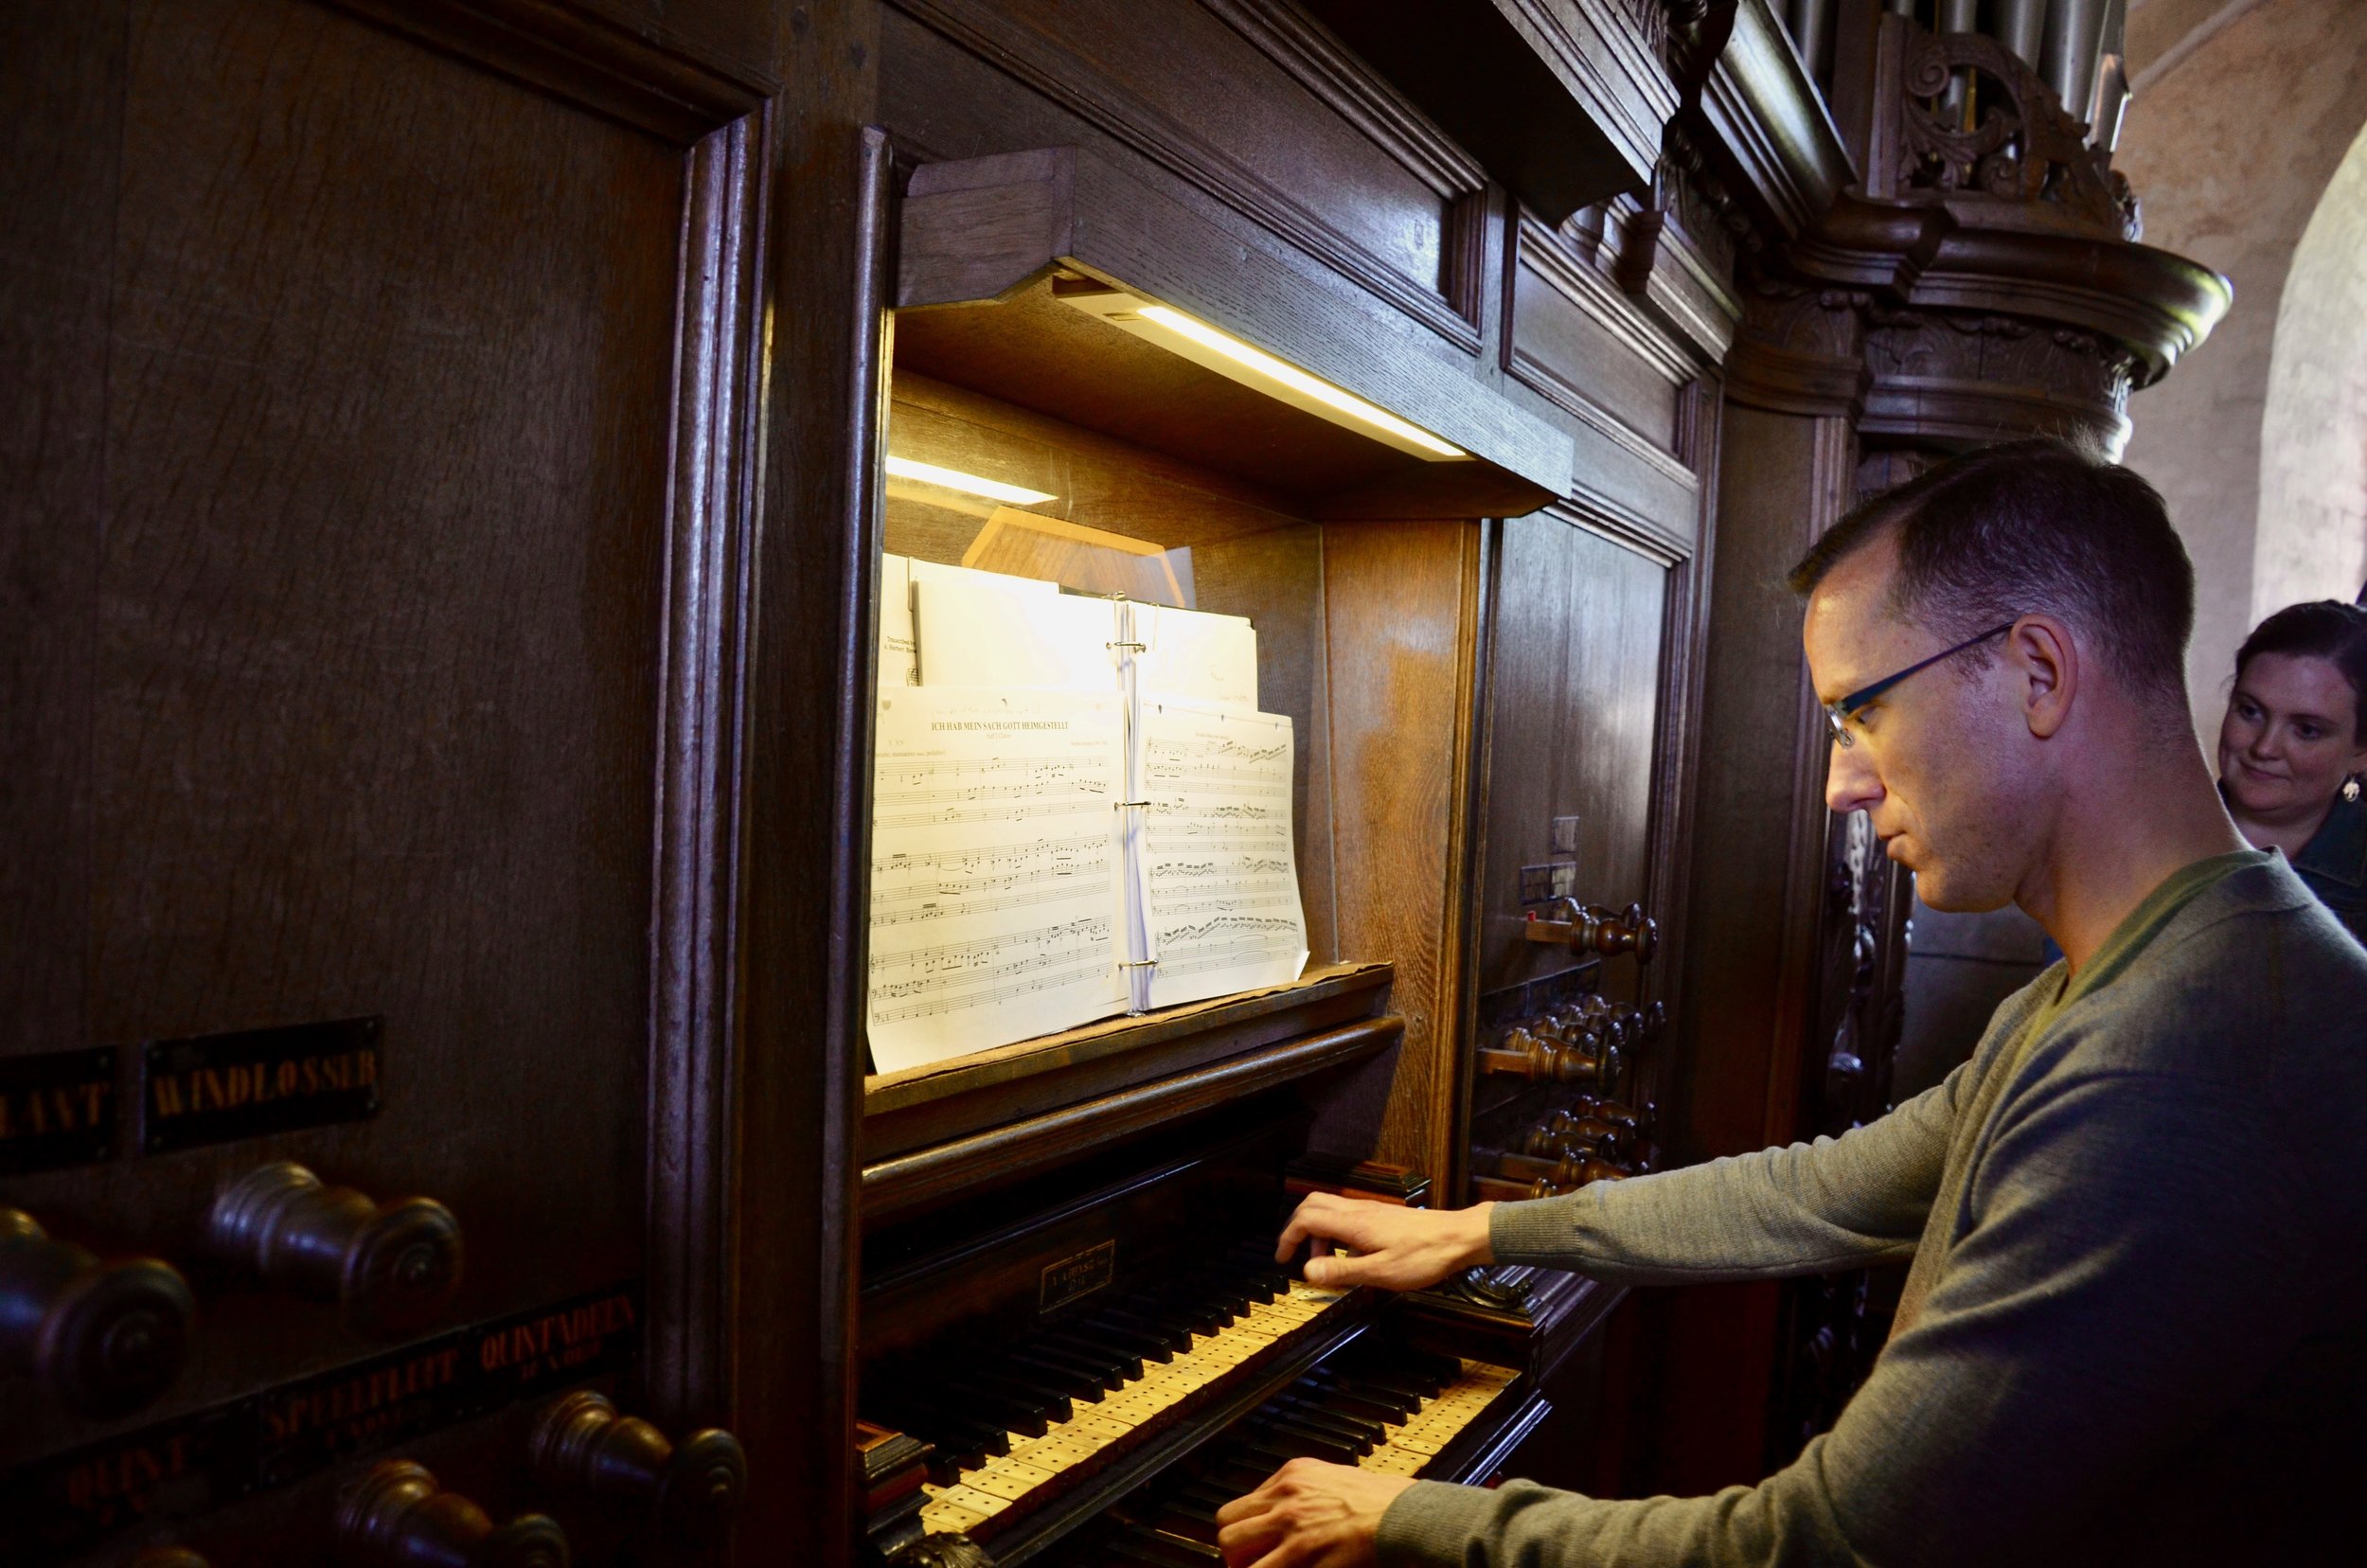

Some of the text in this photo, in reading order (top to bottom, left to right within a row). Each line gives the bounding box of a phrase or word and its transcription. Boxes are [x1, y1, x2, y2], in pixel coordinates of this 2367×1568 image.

[931, 721, 1068, 731] ICH HAB MEIN SACH GOTT HEIMGESTELLT
[151, 1049, 377, 1120] WINDLOSSER
